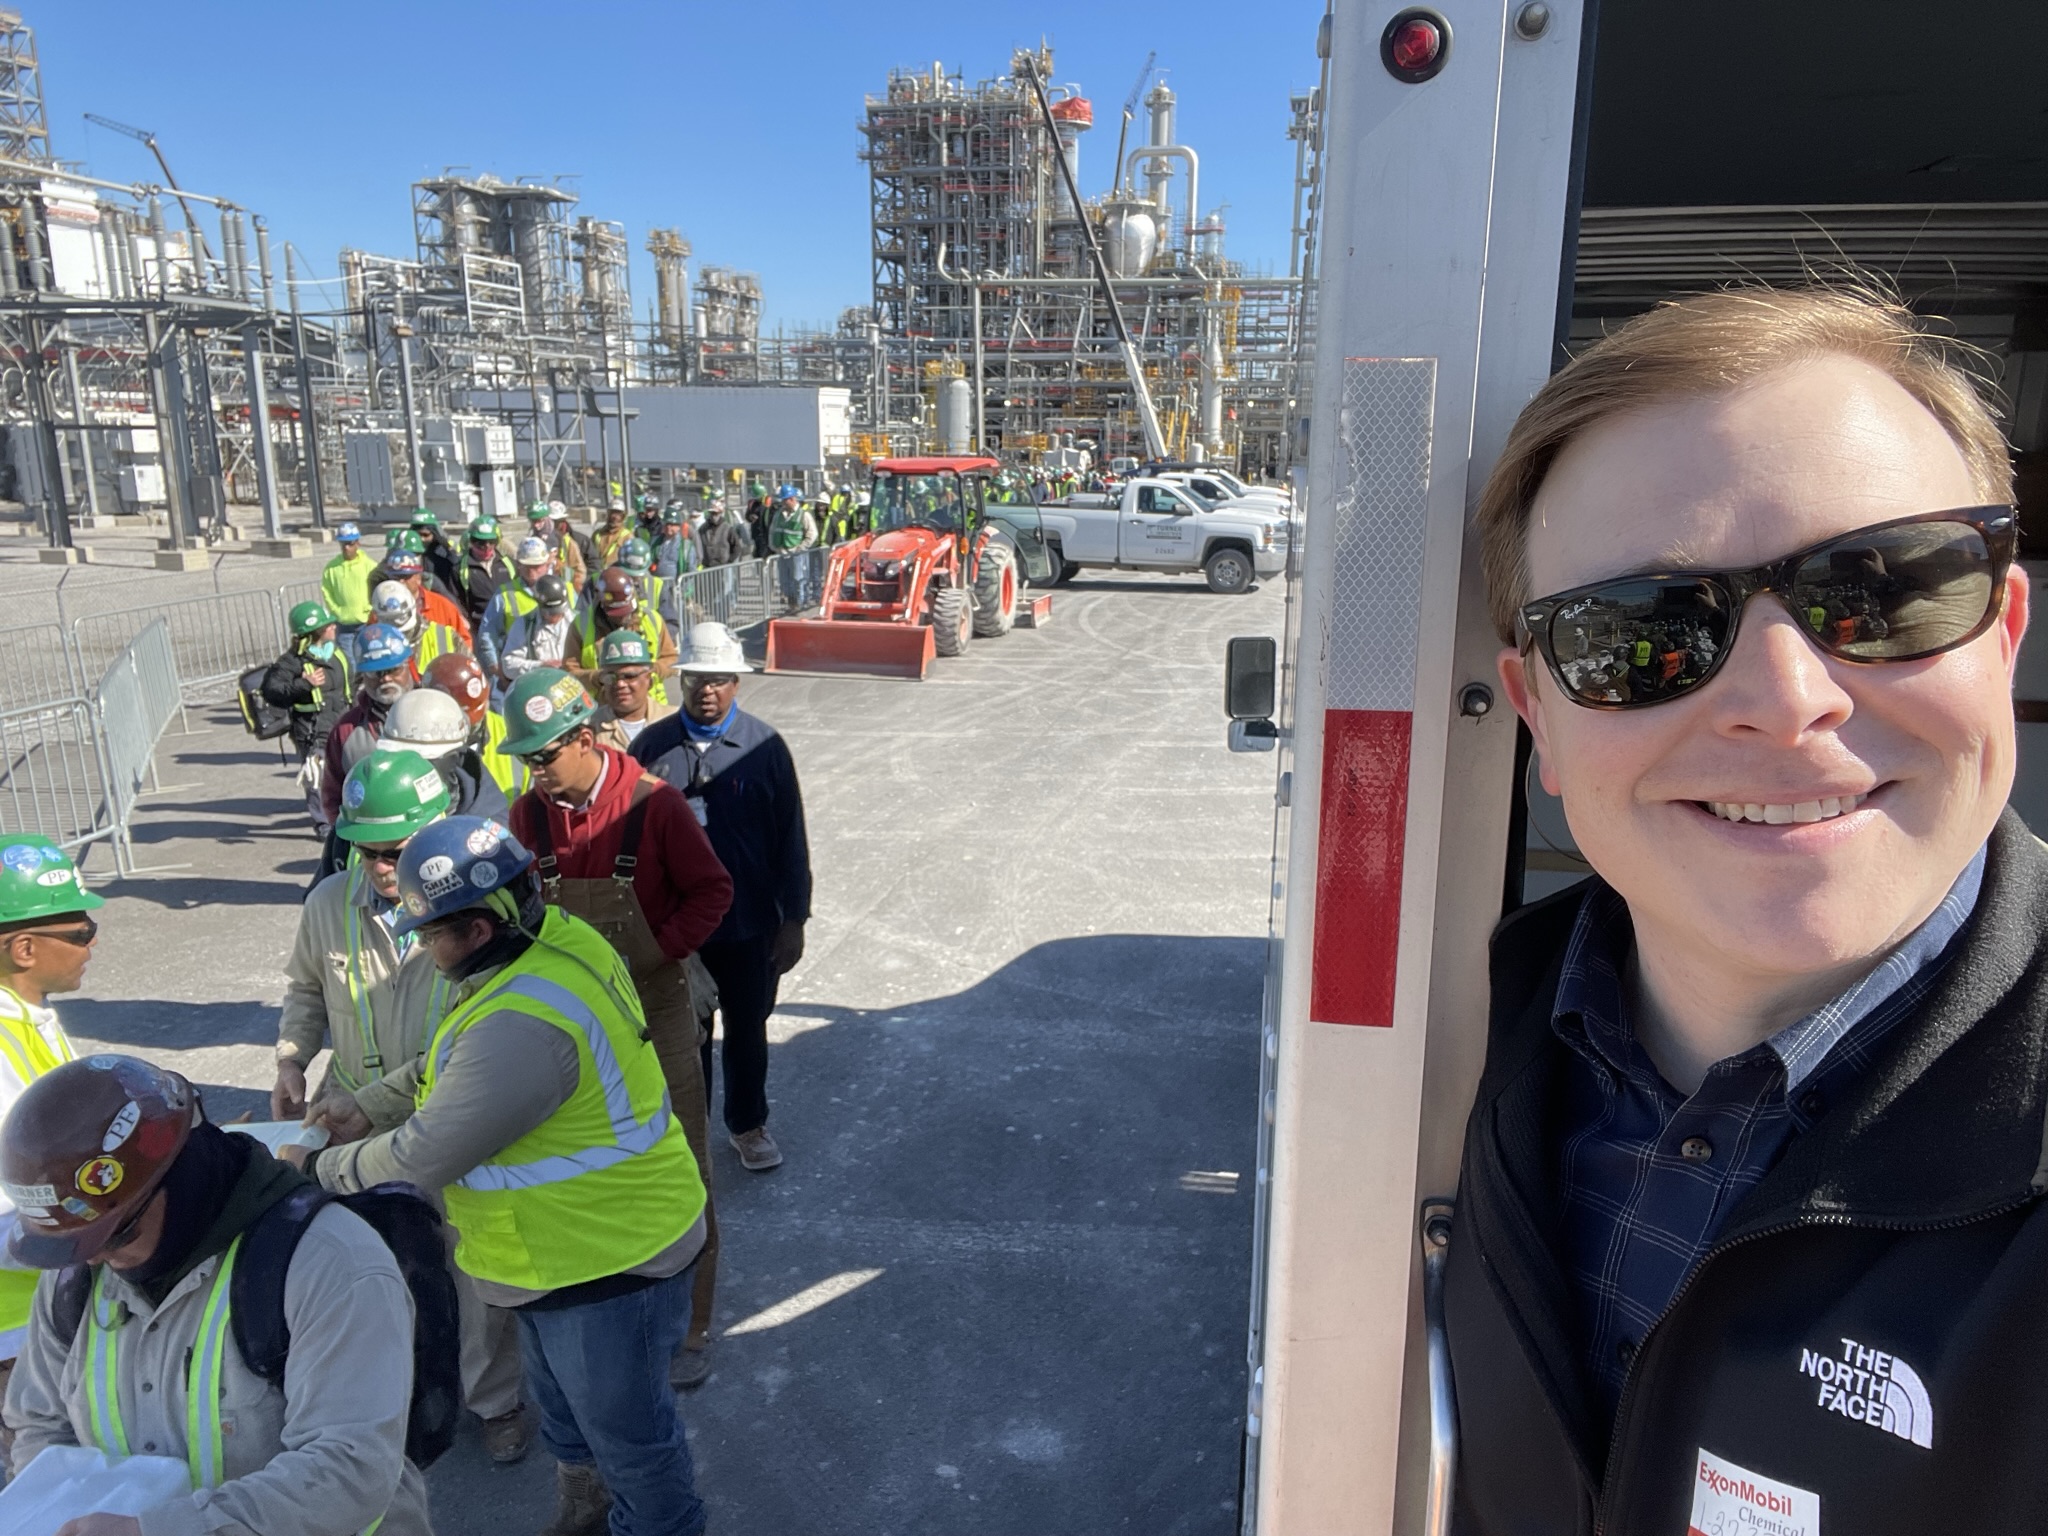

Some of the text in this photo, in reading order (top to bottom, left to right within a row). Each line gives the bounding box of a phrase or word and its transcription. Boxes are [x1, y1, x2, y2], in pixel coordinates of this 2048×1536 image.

[47, 870, 66, 885] PF
[425, 860, 443, 876] PF
[109, 1108, 134, 1140] PF
[1841, 1337, 1892, 1378] THE
[1799, 1348, 1888, 1404] NORTH
[1817, 1382, 1884, 1427] FACE
[1699, 1461, 1791, 1517] ExxonMobil
[1738, 1506, 1806, 1536] Chemical
